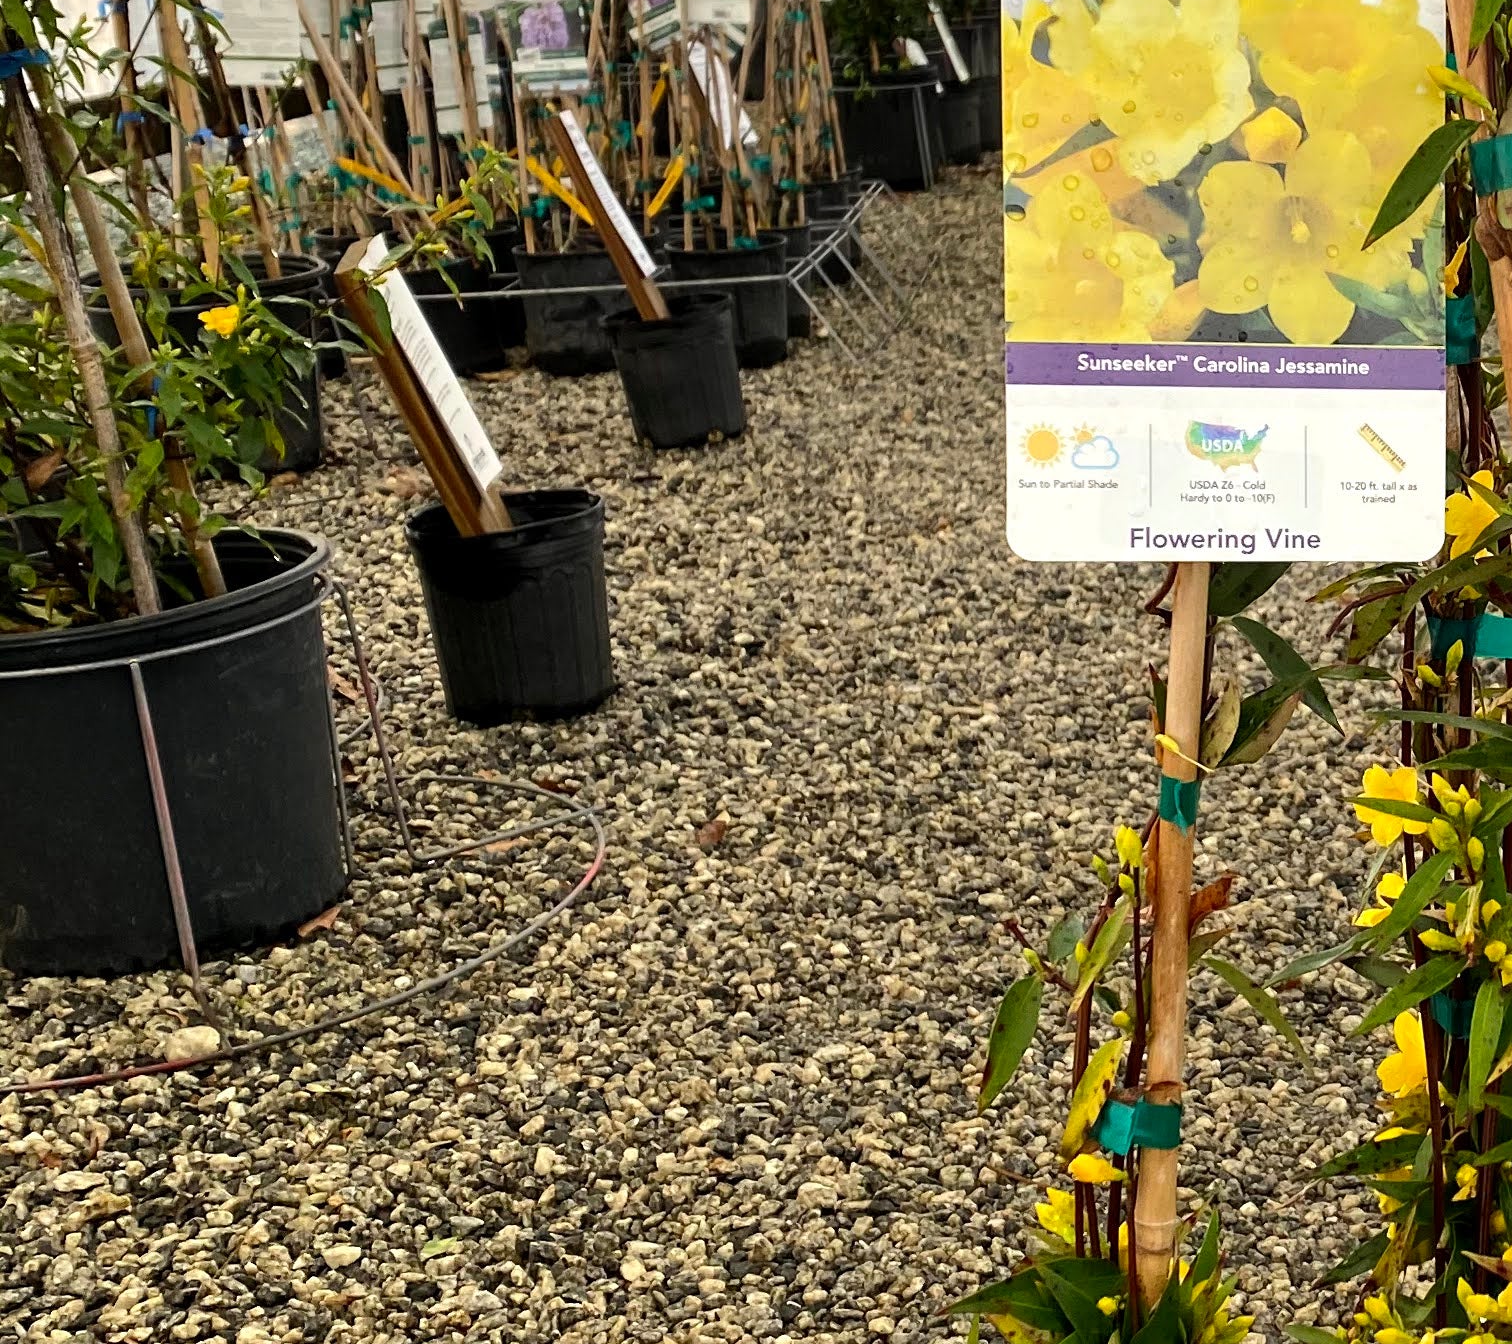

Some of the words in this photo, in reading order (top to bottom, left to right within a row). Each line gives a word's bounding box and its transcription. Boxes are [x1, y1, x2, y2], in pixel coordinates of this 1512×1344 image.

[1193, 356, 1270, 374] Carolina
[1275, 357, 1370, 375] Jessamine
[1201, 439, 1244, 453] USDA
[1018, 479, 1037, 488] Sun
[1039, 480, 1051, 488] to
[1053, 479, 1085, 488] Partial
[1087, 479, 1119, 489] Shade
[1189, 480, 1219, 490] USDA
[1221, 480, 1234, 490] Z6
[1243, 480, 1266, 490] Cold
[1340, 481, 1367, 491] 10-20
[1382, 481, 1397, 491] tall
[1180, 493, 1209, 504] Hardy
[1211, 495, 1223, 503] to
[1234, 494, 1245, 503] to
[1361, 494, 1396, 504] trained
[1130, 526, 1256, 555] Flowering
[1265, 528, 1321, 549] Vine
